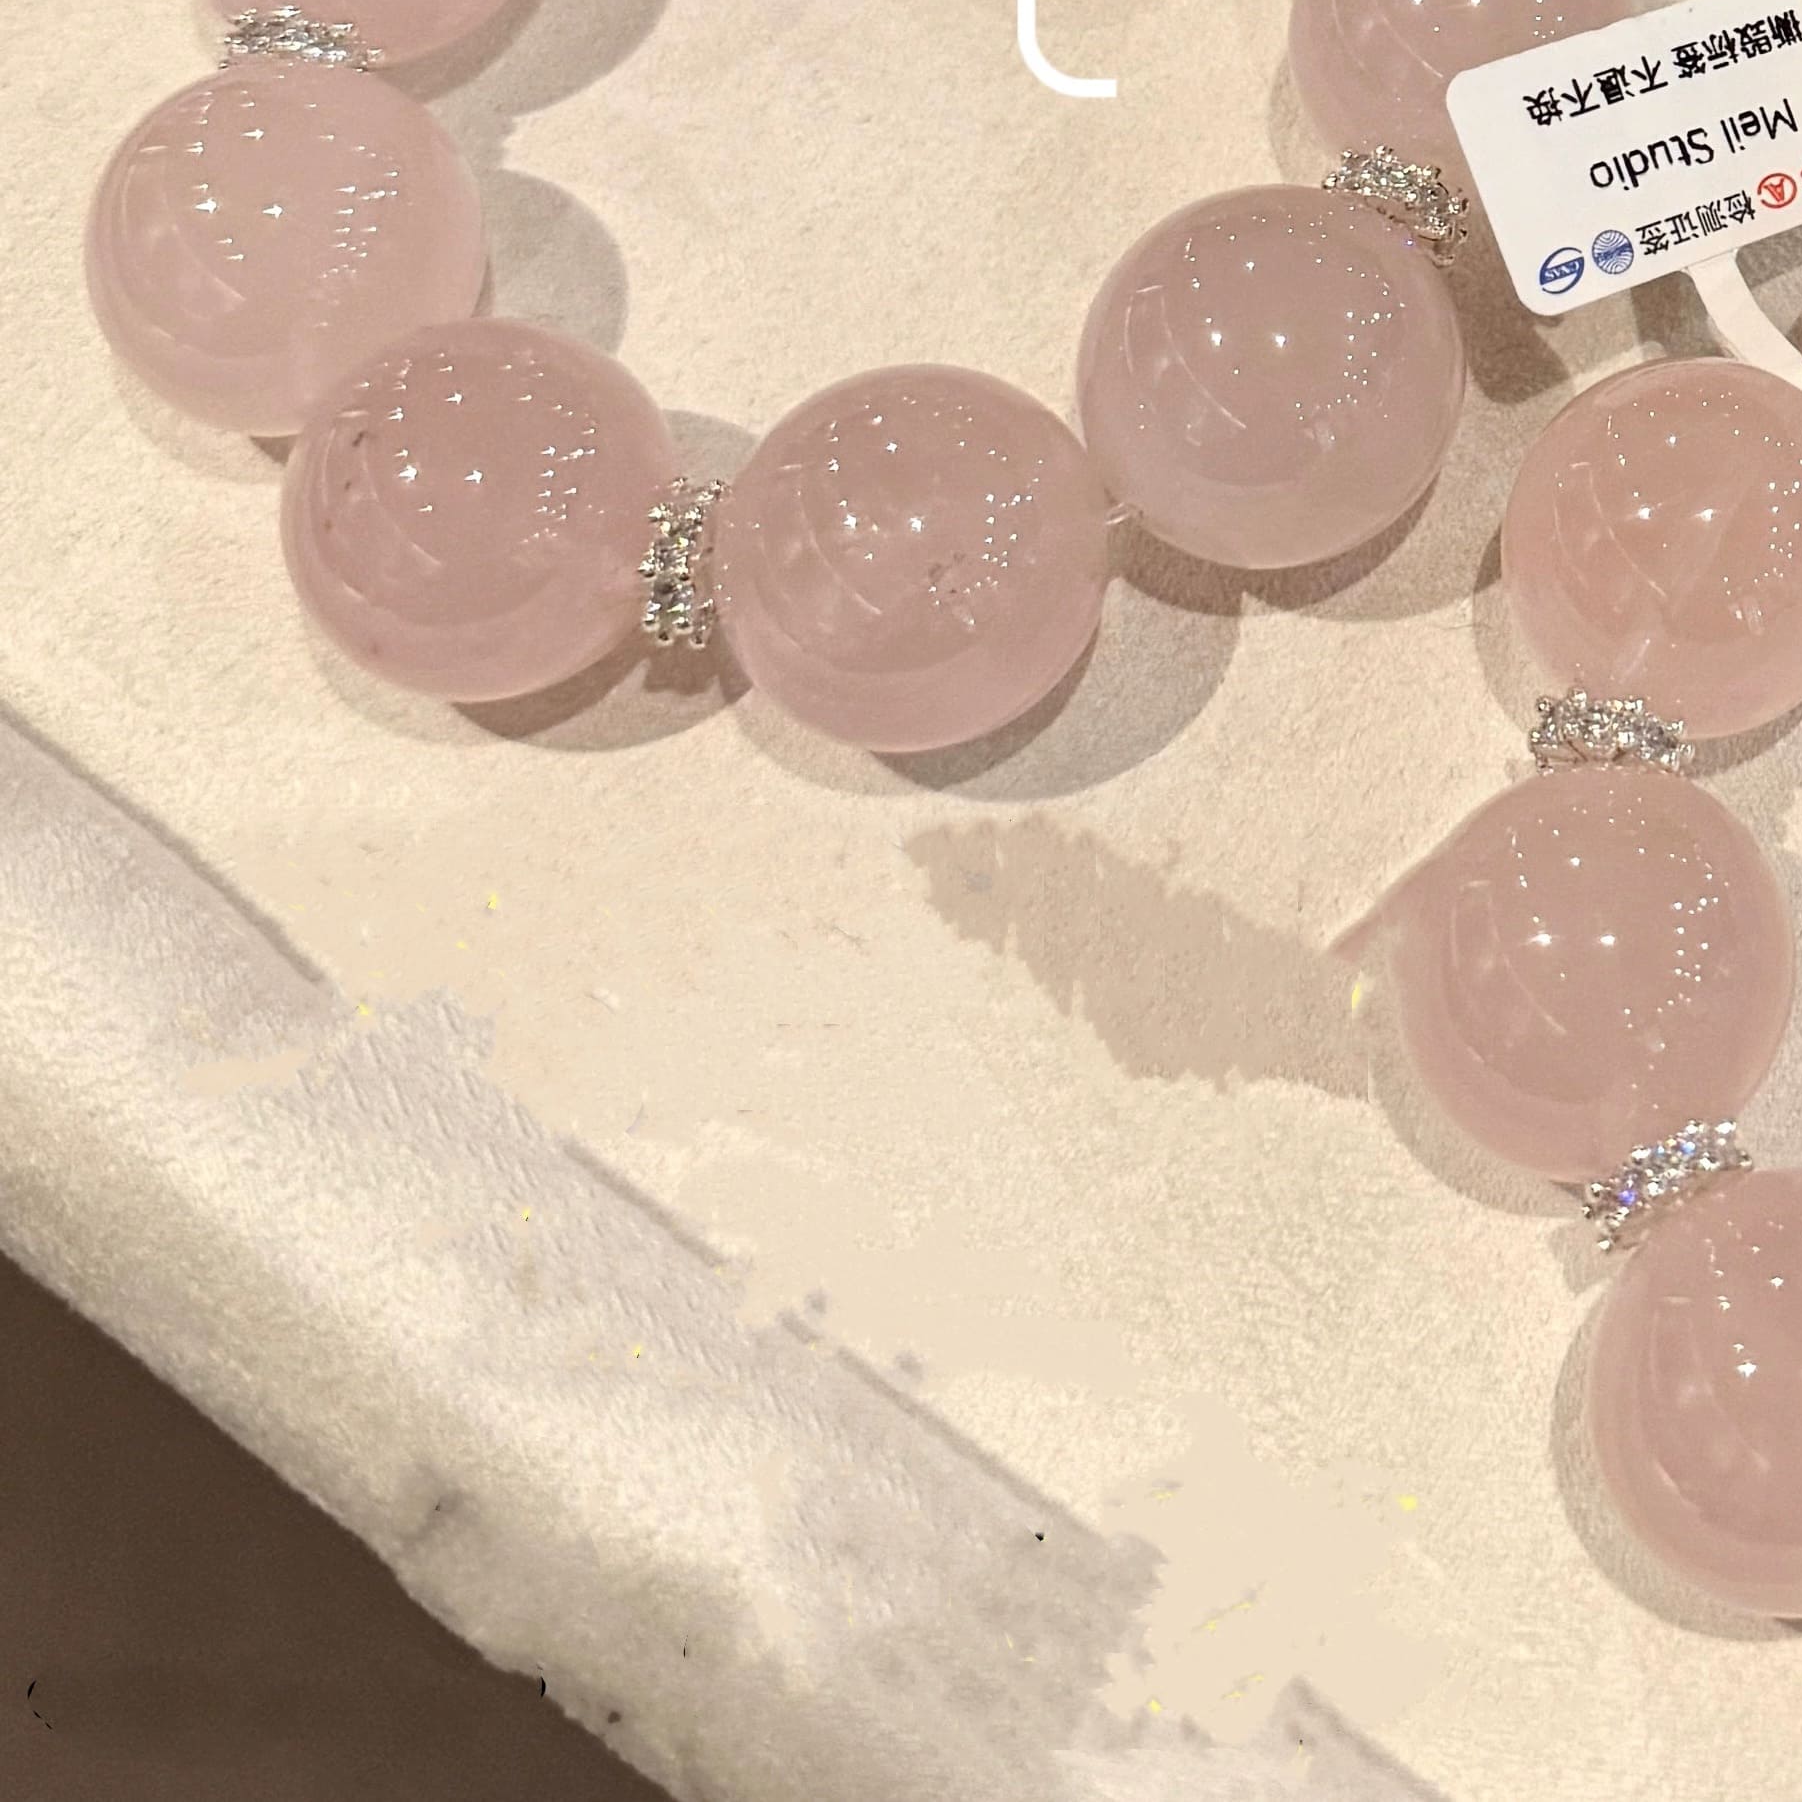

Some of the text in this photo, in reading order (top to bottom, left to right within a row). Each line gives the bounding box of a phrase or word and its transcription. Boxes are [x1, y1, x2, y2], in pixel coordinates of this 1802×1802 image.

[1522, 55, 1669, 127] 不退不换
[1589, 98, 1799, 191] Meil Studio
[1634, 189, 1756, 256] 检测证签
